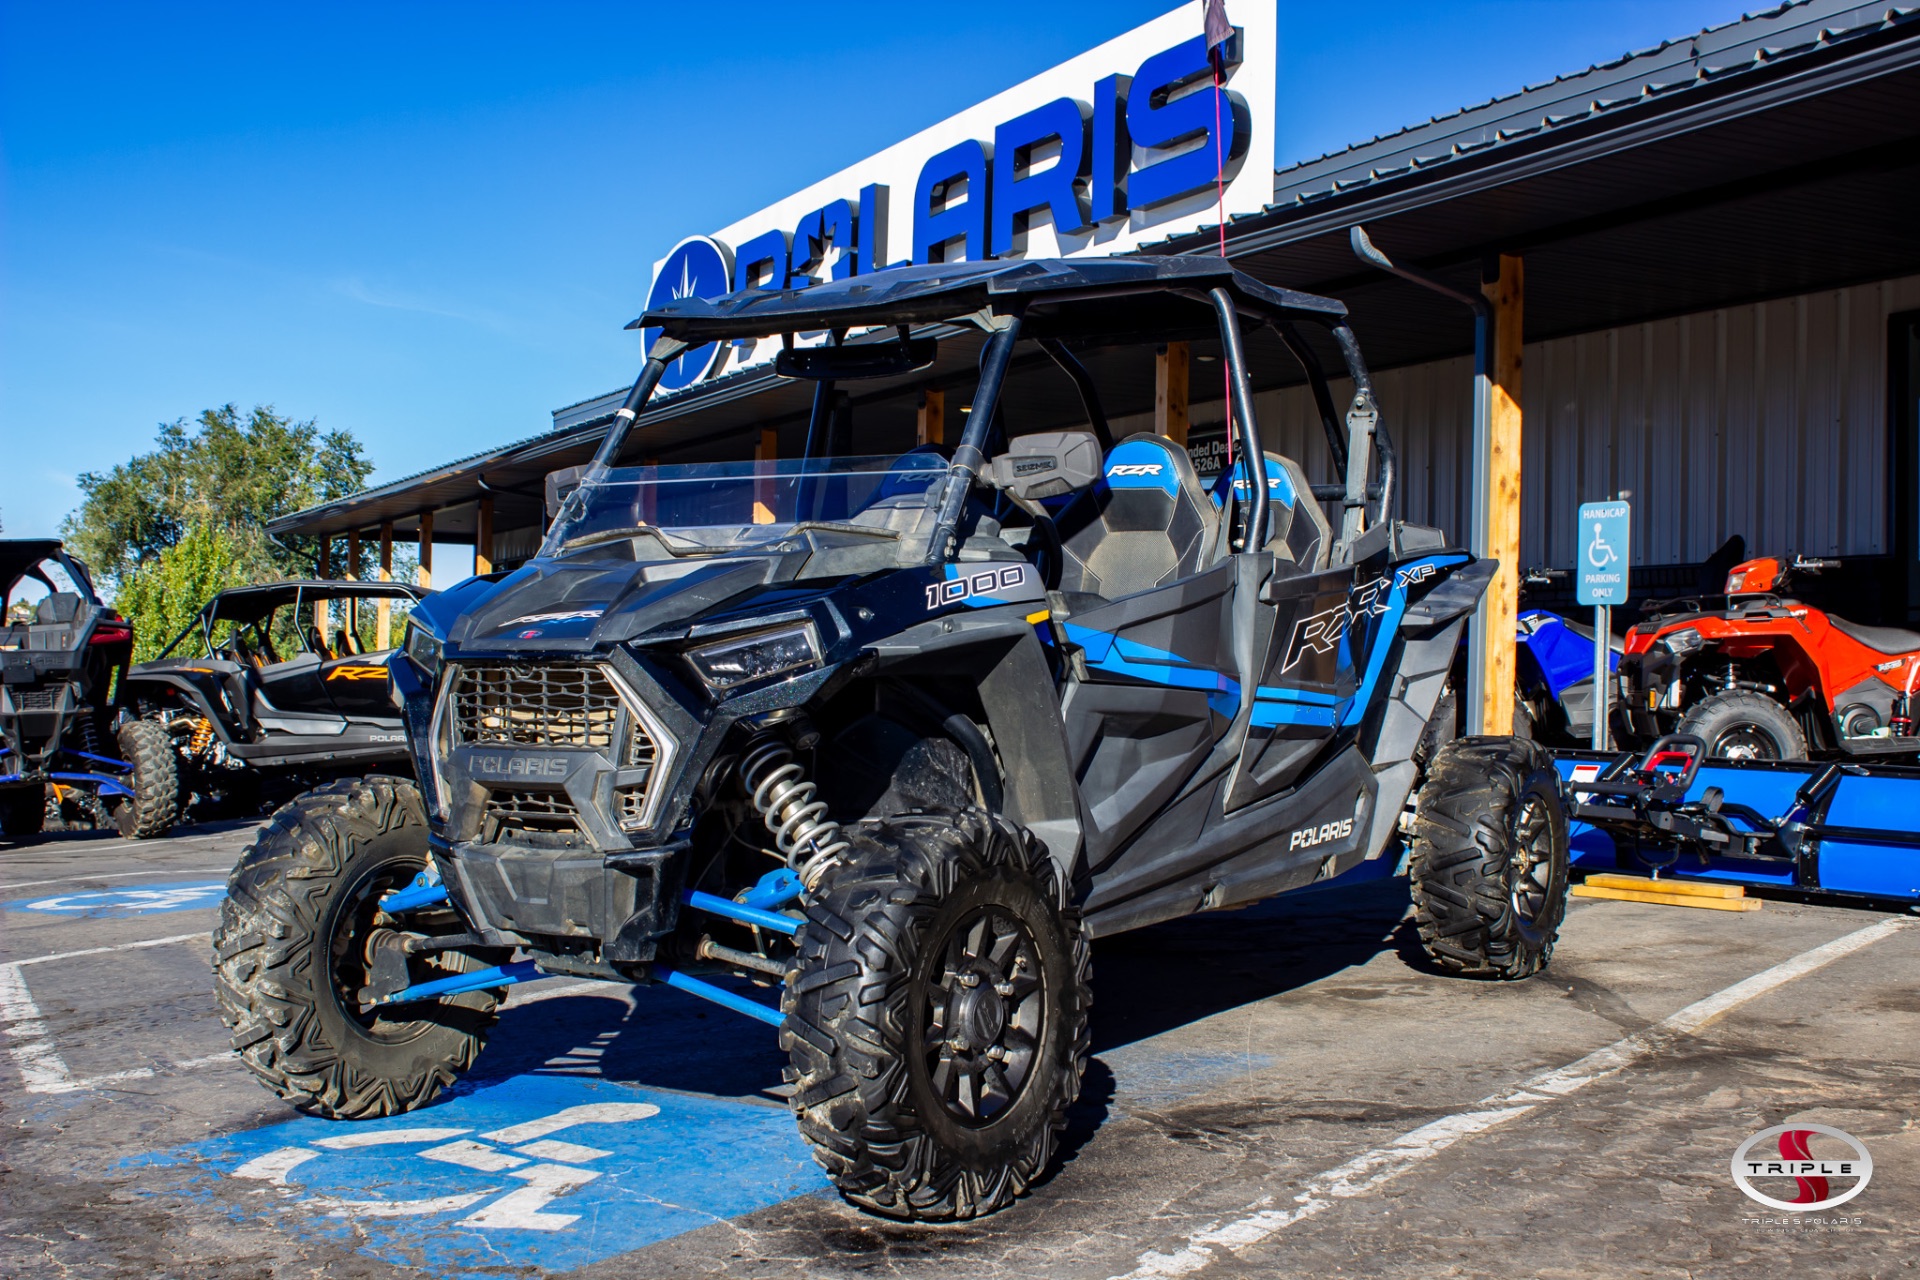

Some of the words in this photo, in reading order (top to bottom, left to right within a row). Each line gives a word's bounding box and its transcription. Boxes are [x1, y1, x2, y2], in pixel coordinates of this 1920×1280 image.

[733, 26, 1248, 343] POLARIS
[1188, 441, 1210, 458] nded
[1212, 440, 1239, 455] Deae
[1106, 464, 1164, 478] RZR
[1233, 478, 1281, 489] RR
[1583, 507, 1626, 519] HANDICAP
[1396, 563, 1436, 589] XP
[1585, 573, 1620, 584] PARKING
[925, 564, 1025, 610] 1000
[1592, 587, 1613, 598] ONLY
[326, 666, 389, 681] RZ
[468, 755, 568, 775] POLARIS
[1289, 818, 1353, 851] POLARIS
